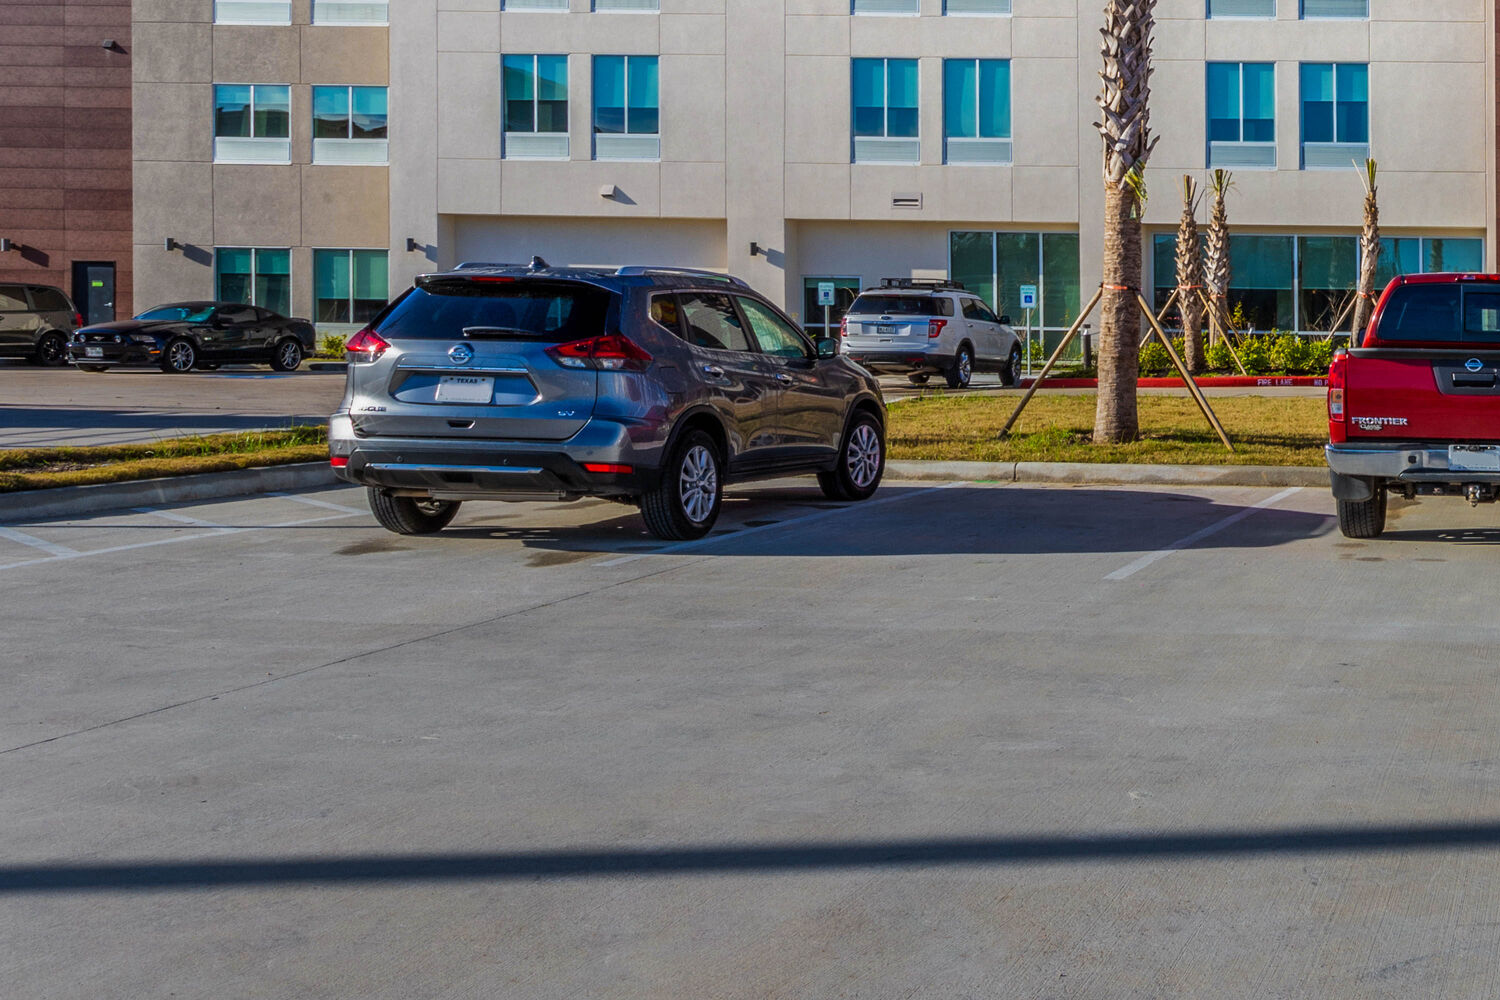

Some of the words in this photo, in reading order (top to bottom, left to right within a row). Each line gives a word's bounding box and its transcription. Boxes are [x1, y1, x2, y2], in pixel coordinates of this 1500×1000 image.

[1257, 378, 1272, 386] FIRE
[1275, 378, 1293, 386] LANE
[1351, 416, 1408, 426] FRONTIER
